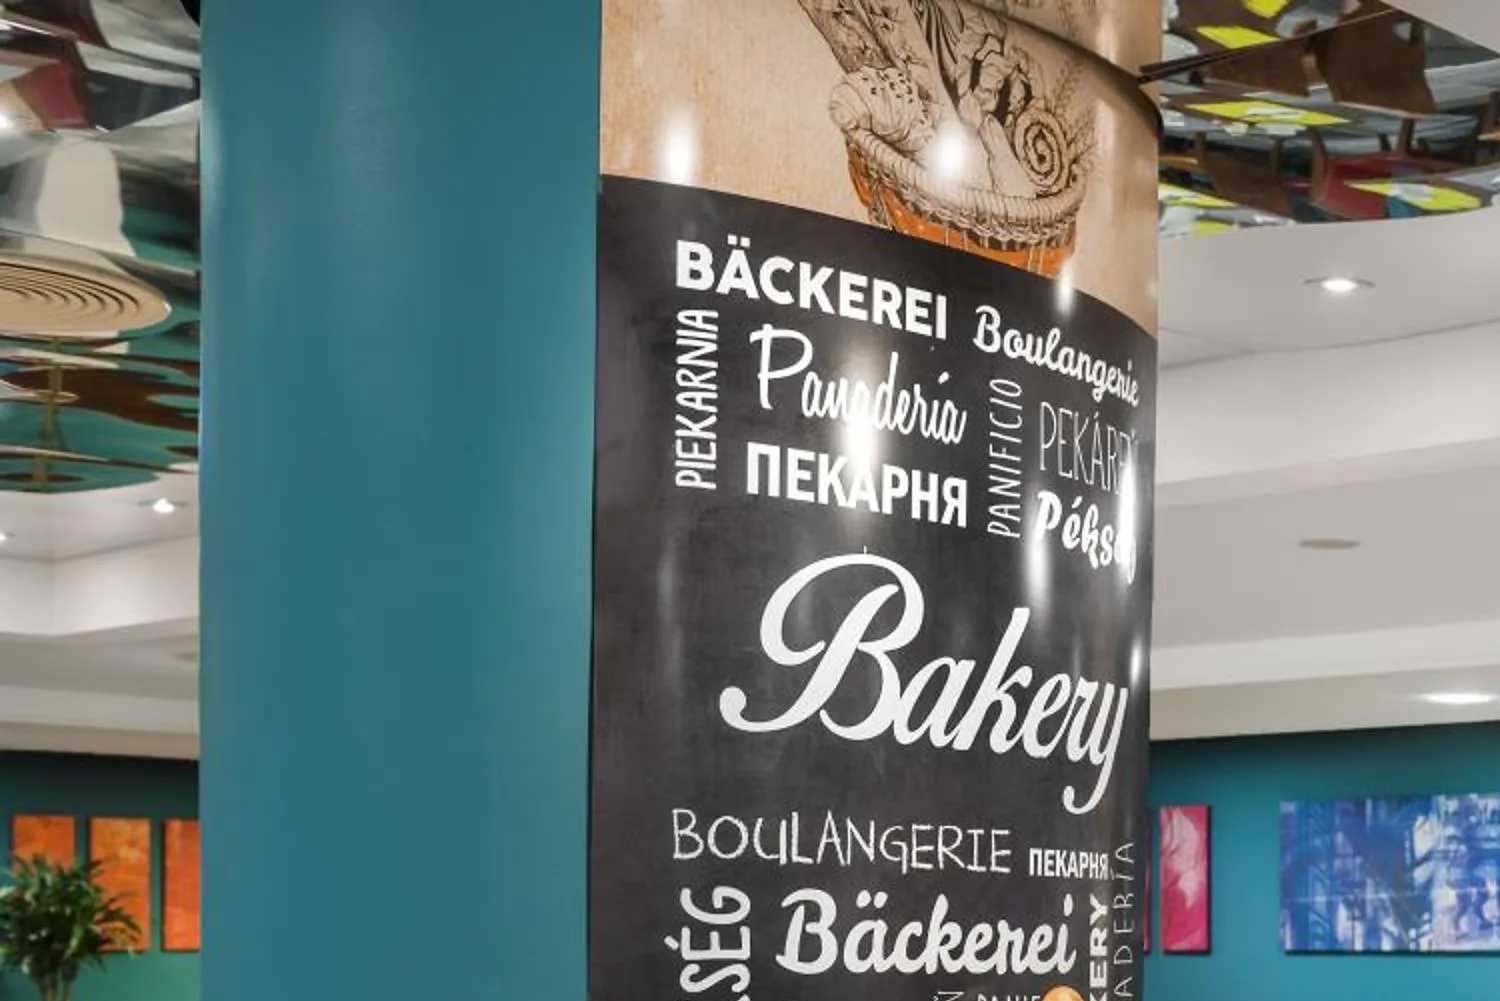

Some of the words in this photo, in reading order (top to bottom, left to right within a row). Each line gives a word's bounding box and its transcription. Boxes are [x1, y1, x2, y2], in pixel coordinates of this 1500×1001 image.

[676, 234, 947, 340] BÄCKEREI
[676, 308, 719, 490] PIEKARNIA
[749, 323, 967, 446] Panadería
[973, 304, 1140, 407] Boulangerie
[746, 441, 967, 529] ПЕКАРНЯ
[987, 378, 1023, 539] PANIFICIO
[719, 551, 1129, 815] Bakery
[672, 808, 1013, 876] BOULANGERIE
[1029, 848, 1109, 880] ПЕКАРНЯ
[775, 887, 1076, 977] Bäckerei
